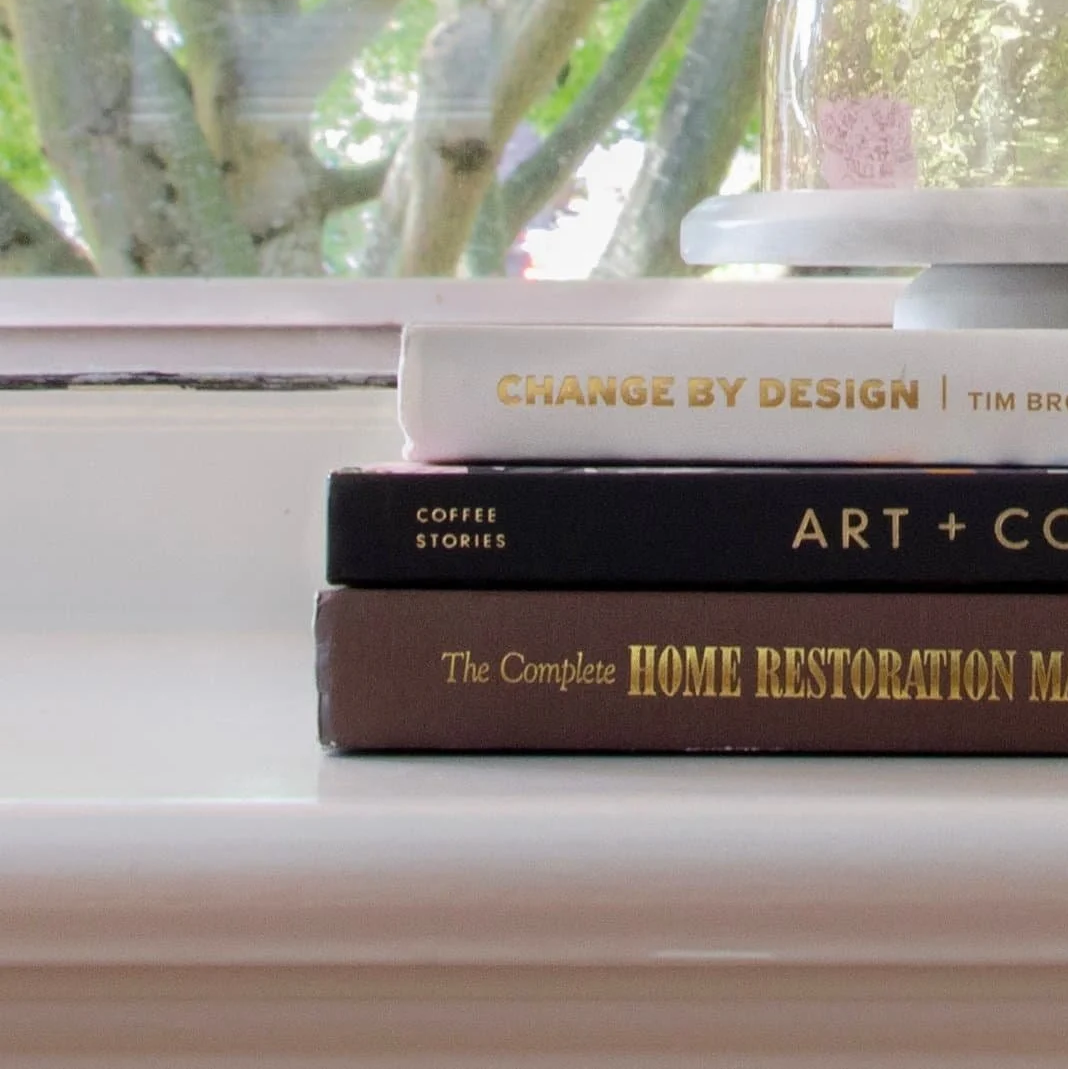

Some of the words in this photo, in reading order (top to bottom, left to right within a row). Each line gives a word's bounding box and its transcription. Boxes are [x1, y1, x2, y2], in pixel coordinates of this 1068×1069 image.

[498, 375, 674, 407] CHANGE
[688, 378, 745, 407] BY
[760, 379, 919, 410] DESIGN
[968, 392, 1015, 410] TIM
[417, 508, 495, 523] COFFEE
[792, 508, 908, 549] ART
[939, 513, 966, 540] +
[416, 533, 505, 548] STORIES
[441, 651, 489, 682] The
[501, 651, 615, 691] Complete
[628, 645, 740, 696] HOME
[755, 647, 1016, 700] RESTORATION
